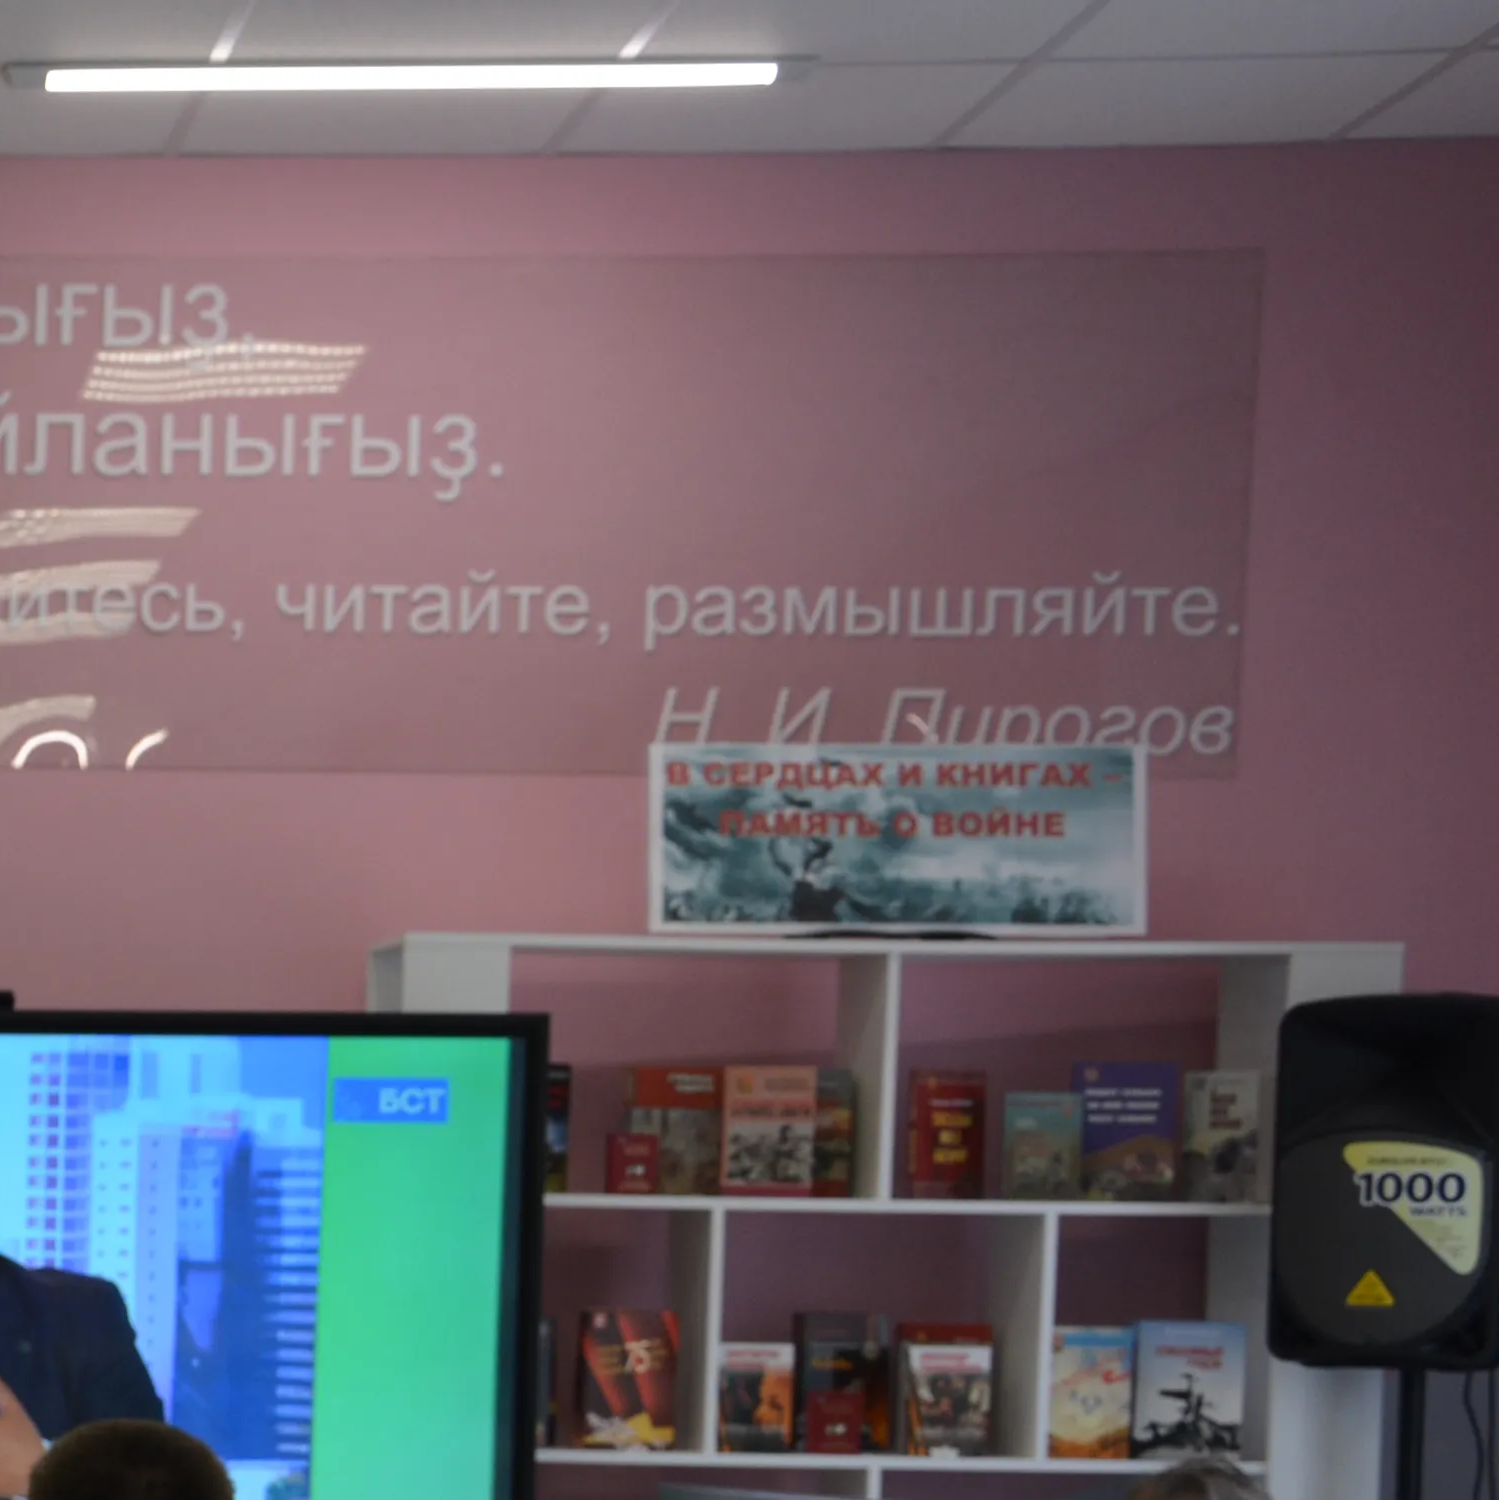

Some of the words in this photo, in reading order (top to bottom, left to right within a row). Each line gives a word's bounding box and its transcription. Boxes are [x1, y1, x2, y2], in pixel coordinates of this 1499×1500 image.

[276, 568, 612, 646] читайте,
[642, 568, 1242, 652] размышляйте.
[880, 686, 1236, 757] Пирогов
[665, 762, 690, 787] В
[704, 761, 887, 793] СЕРДЦАХ
[898, 761, 923, 788] И
[937, 761, 1094, 789] КНИГАХ
[718, 811, 882, 839] ПАМЯТЬ
[892, 811, 920, 839] О
[932, 804, 1067, 839] ВОЙНЕ
[378, 1086, 448, 1116] БСТ
[1357, 1171, 1467, 1204] 1000
